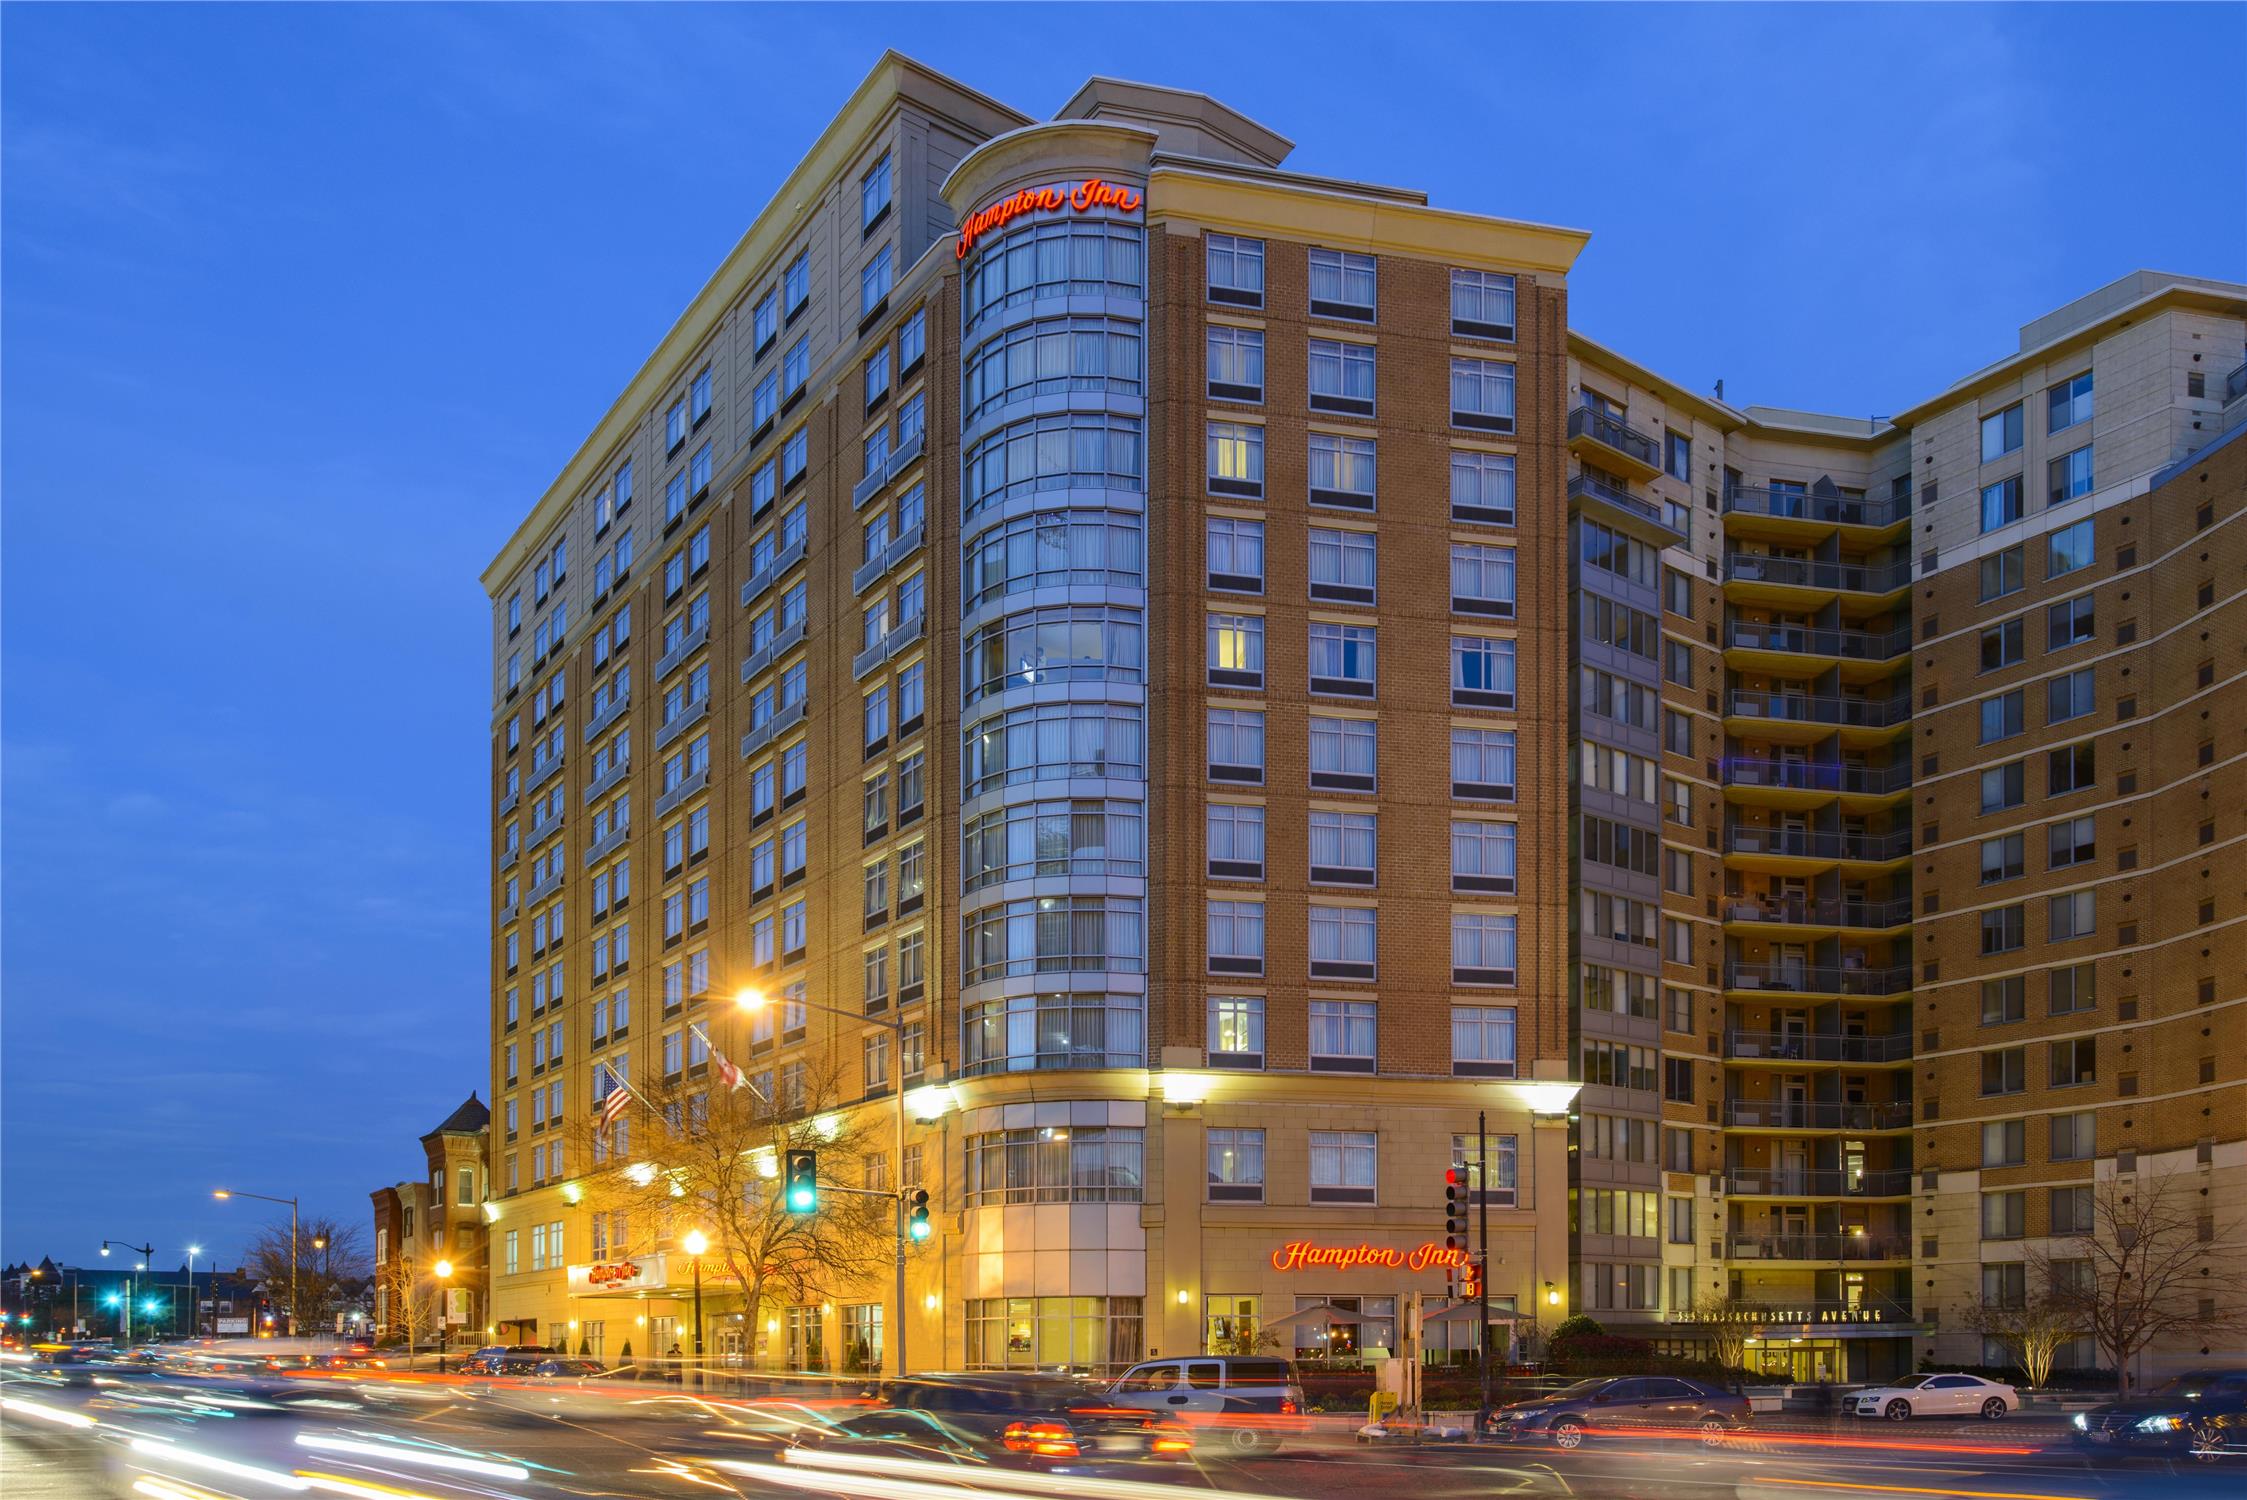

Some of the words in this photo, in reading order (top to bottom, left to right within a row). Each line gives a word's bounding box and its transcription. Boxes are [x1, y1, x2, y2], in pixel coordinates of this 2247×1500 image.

[956, 187, 1064, 260] Hampton
[1070, 179, 1140, 212] Inn
[1272, 1241, 1404, 1271] Hampton
[1408, 1242, 1469, 1271] Inn
[1821, 1309, 1881, 1322] AVENUE
